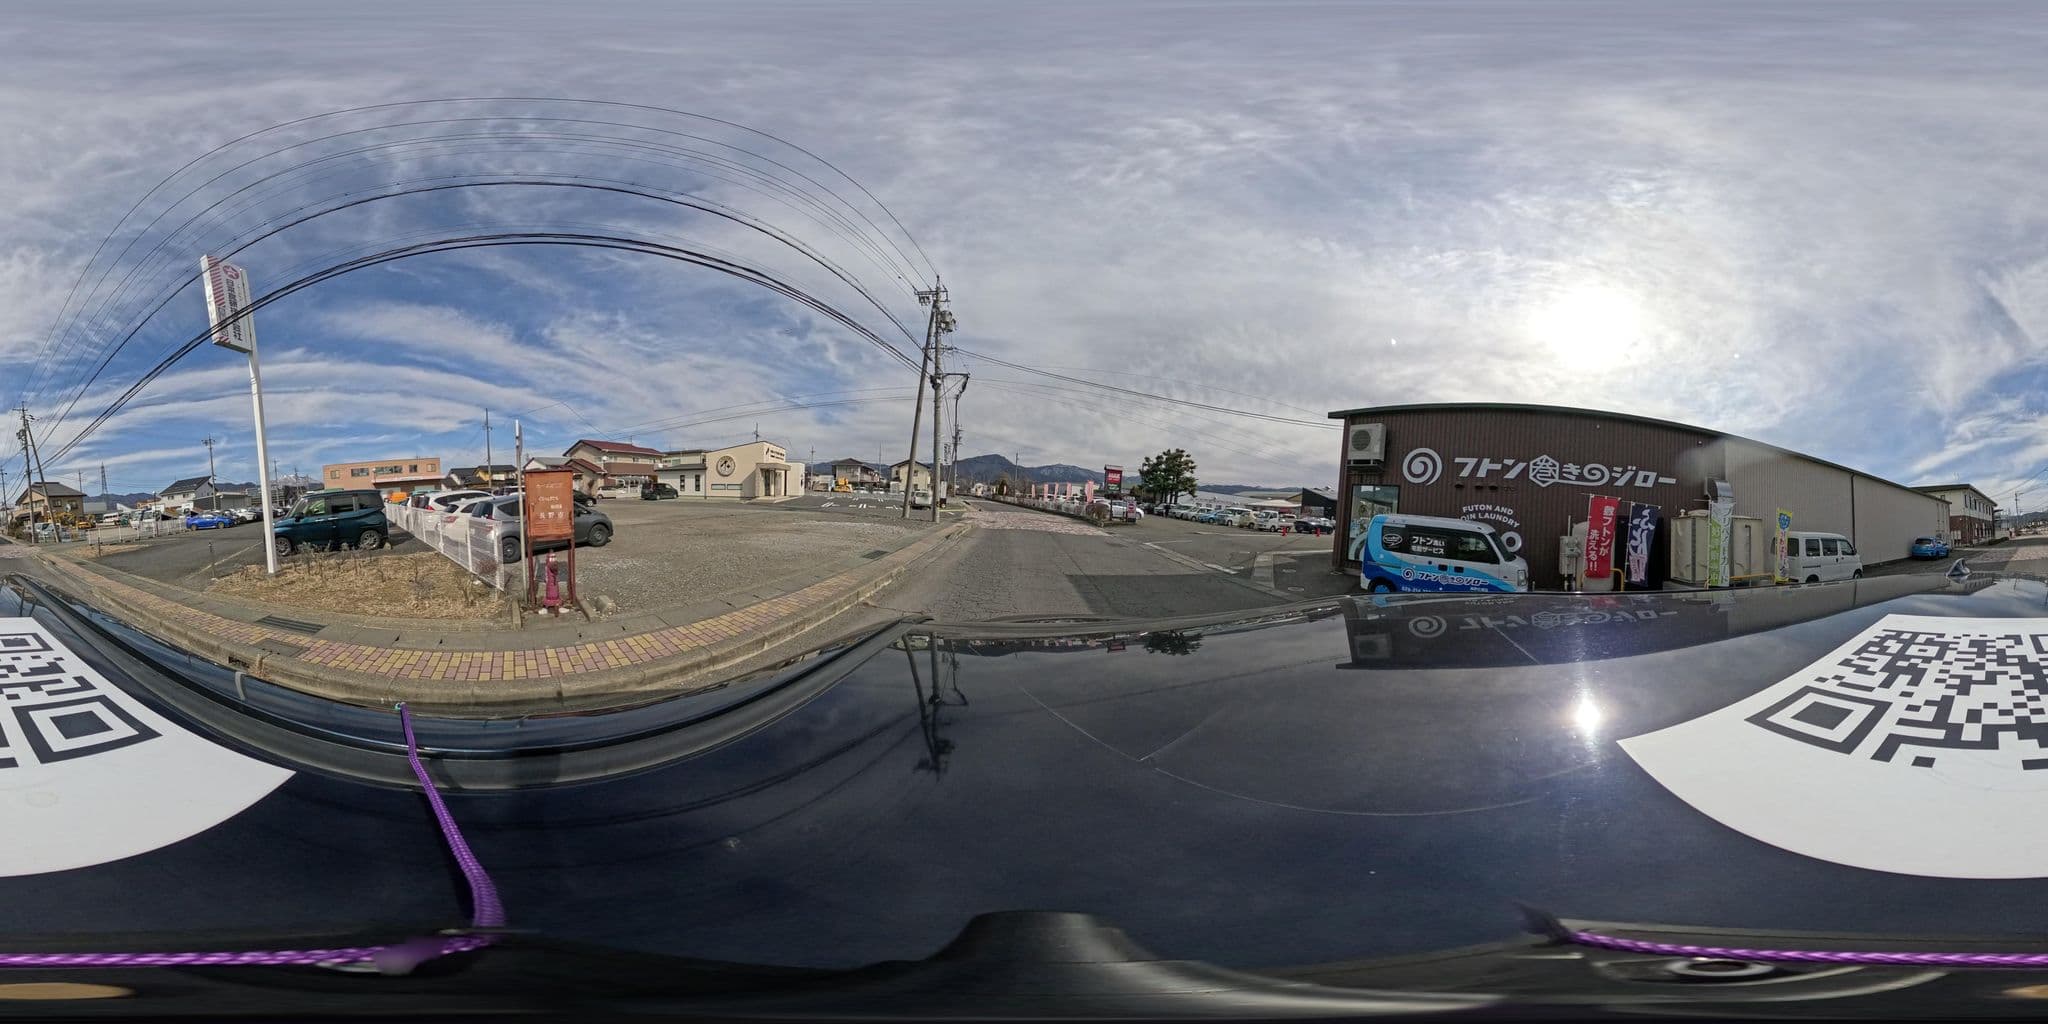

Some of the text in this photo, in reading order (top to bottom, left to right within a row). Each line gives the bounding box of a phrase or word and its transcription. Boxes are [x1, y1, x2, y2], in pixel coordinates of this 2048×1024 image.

[1462, 504, 1514, 516] FUTON AND
[1459, 513, 1521, 528] OIN LAUNDRY
